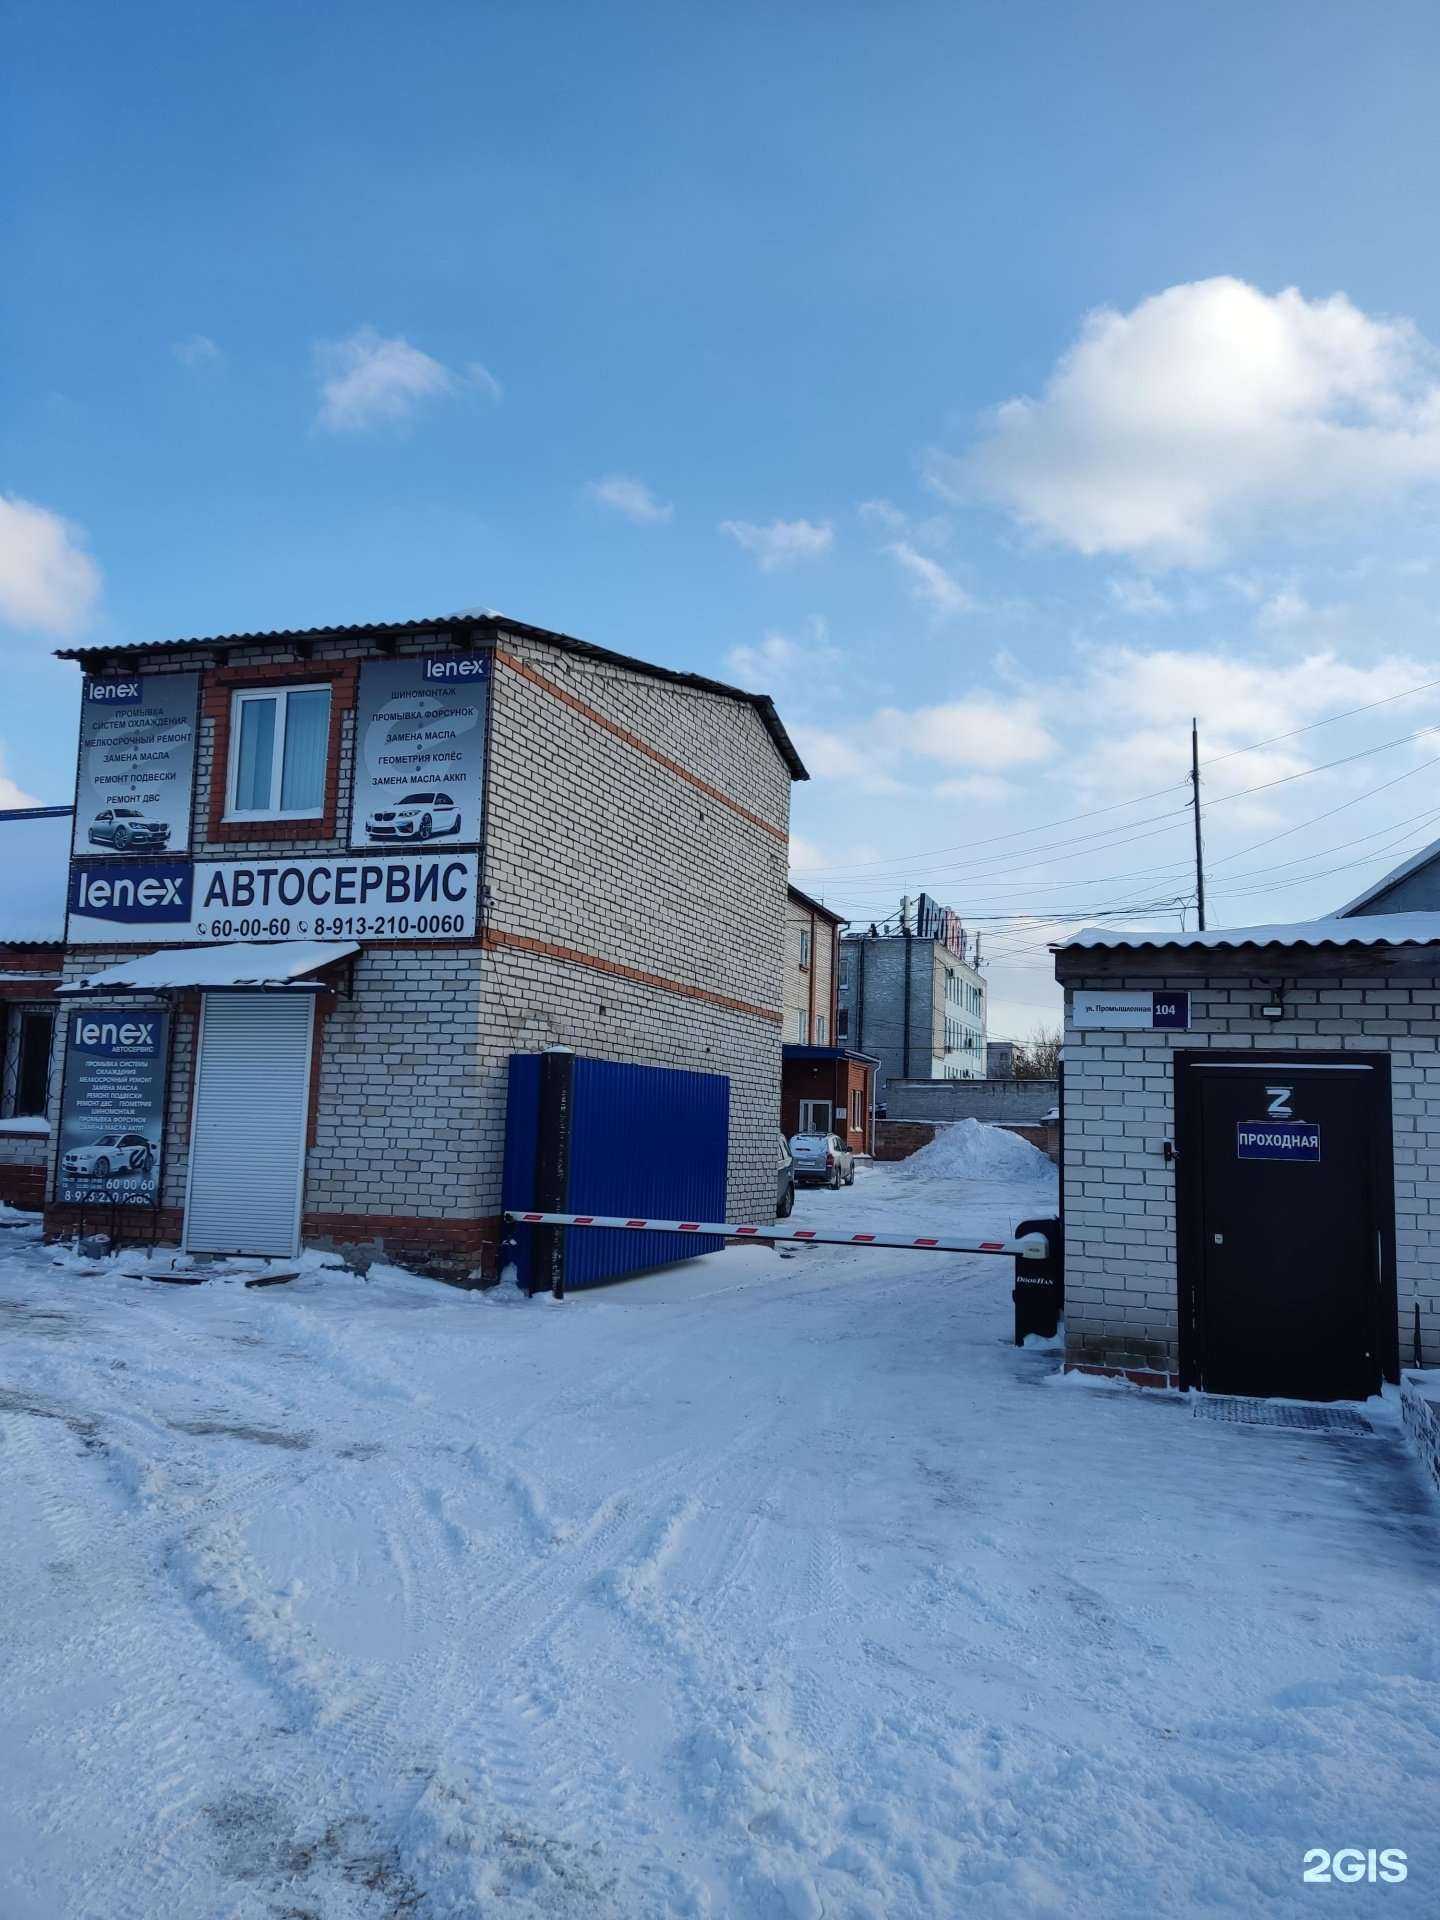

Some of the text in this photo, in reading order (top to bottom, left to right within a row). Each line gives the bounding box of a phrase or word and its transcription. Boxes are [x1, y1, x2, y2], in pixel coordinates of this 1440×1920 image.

[426, 659, 484, 678] lenex
[88, 682, 139, 700] lenex
[391, 687, 457, 700] ШИНОМОНТАЖ
[372, 707, 475, 721] ПРОМЫВКА ФОРСУНОК
[92, 720, 126, 731] СИСТЕМ
[85, 732, 193, 748] МЕЛКОСРОЧНЫЙ РЕМОНТ
[386, 730, 457, 743] ЗАМЕНА МАСЛА
[103, 751, 170, 763] ЗАМЕНА МАСЛА
[378, 753, 431, 765] ГЕОМЕТРИЯ
[94, 771, 177, 785] РЕМОНТ ПОДВЕСКИ
[371, 775, 408, 787] ЗАМЕНА
[410, 773, 442, 784] МАСЛА
[106, 792, 161, 805] РЕМОНТ ДВС
[78, 871, 184, 909] lenex
[202, 861, 469, 908] АВТОСЕРВИС
[211, 914, 465, 937] 60-00-60 8-913-210-0060
[1096, 1004, 1152, 1014] Промышленная
[1155, 1004, 1177, 1016] 104
[75, 1016, 155, 1046] lenex
[1239, 1132, 1319, 1150] ПРОХОДНАЯ
